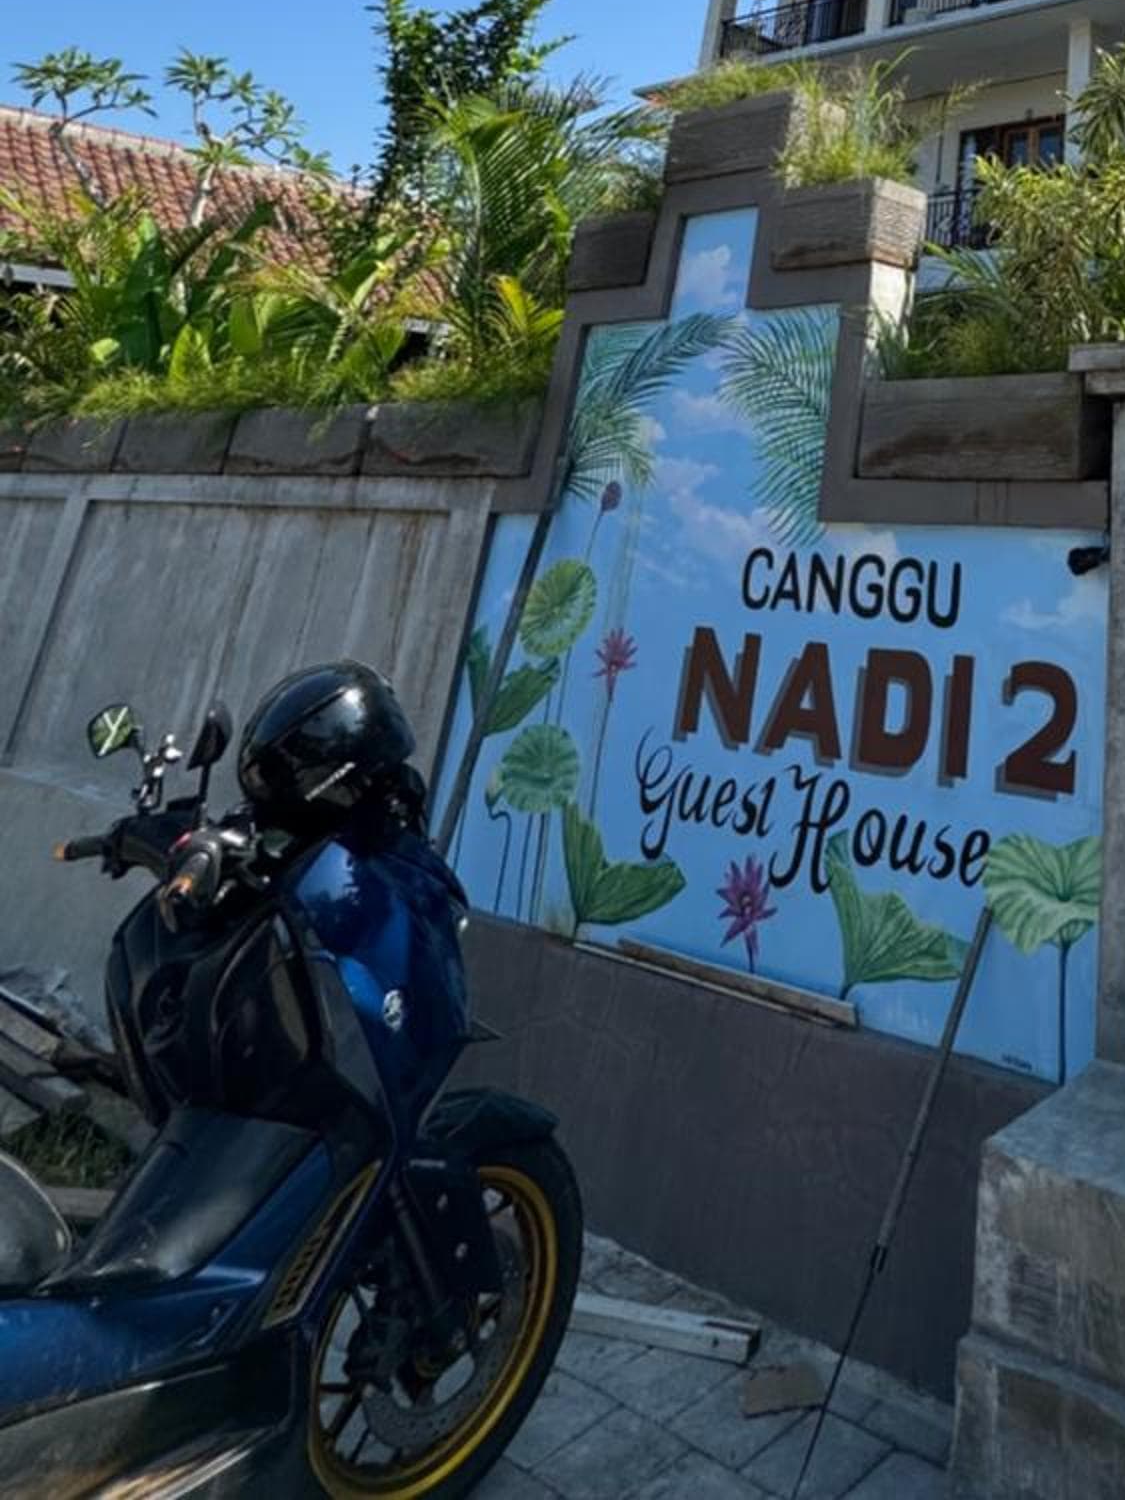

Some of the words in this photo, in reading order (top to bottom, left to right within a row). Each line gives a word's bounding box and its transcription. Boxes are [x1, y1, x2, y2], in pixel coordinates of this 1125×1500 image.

[742, 547, 962, 629] CANGGU
[672, 626, 975, 789] NADI
[994, 660, 1078, 803] 2
[768, 764, 991, 895] House
